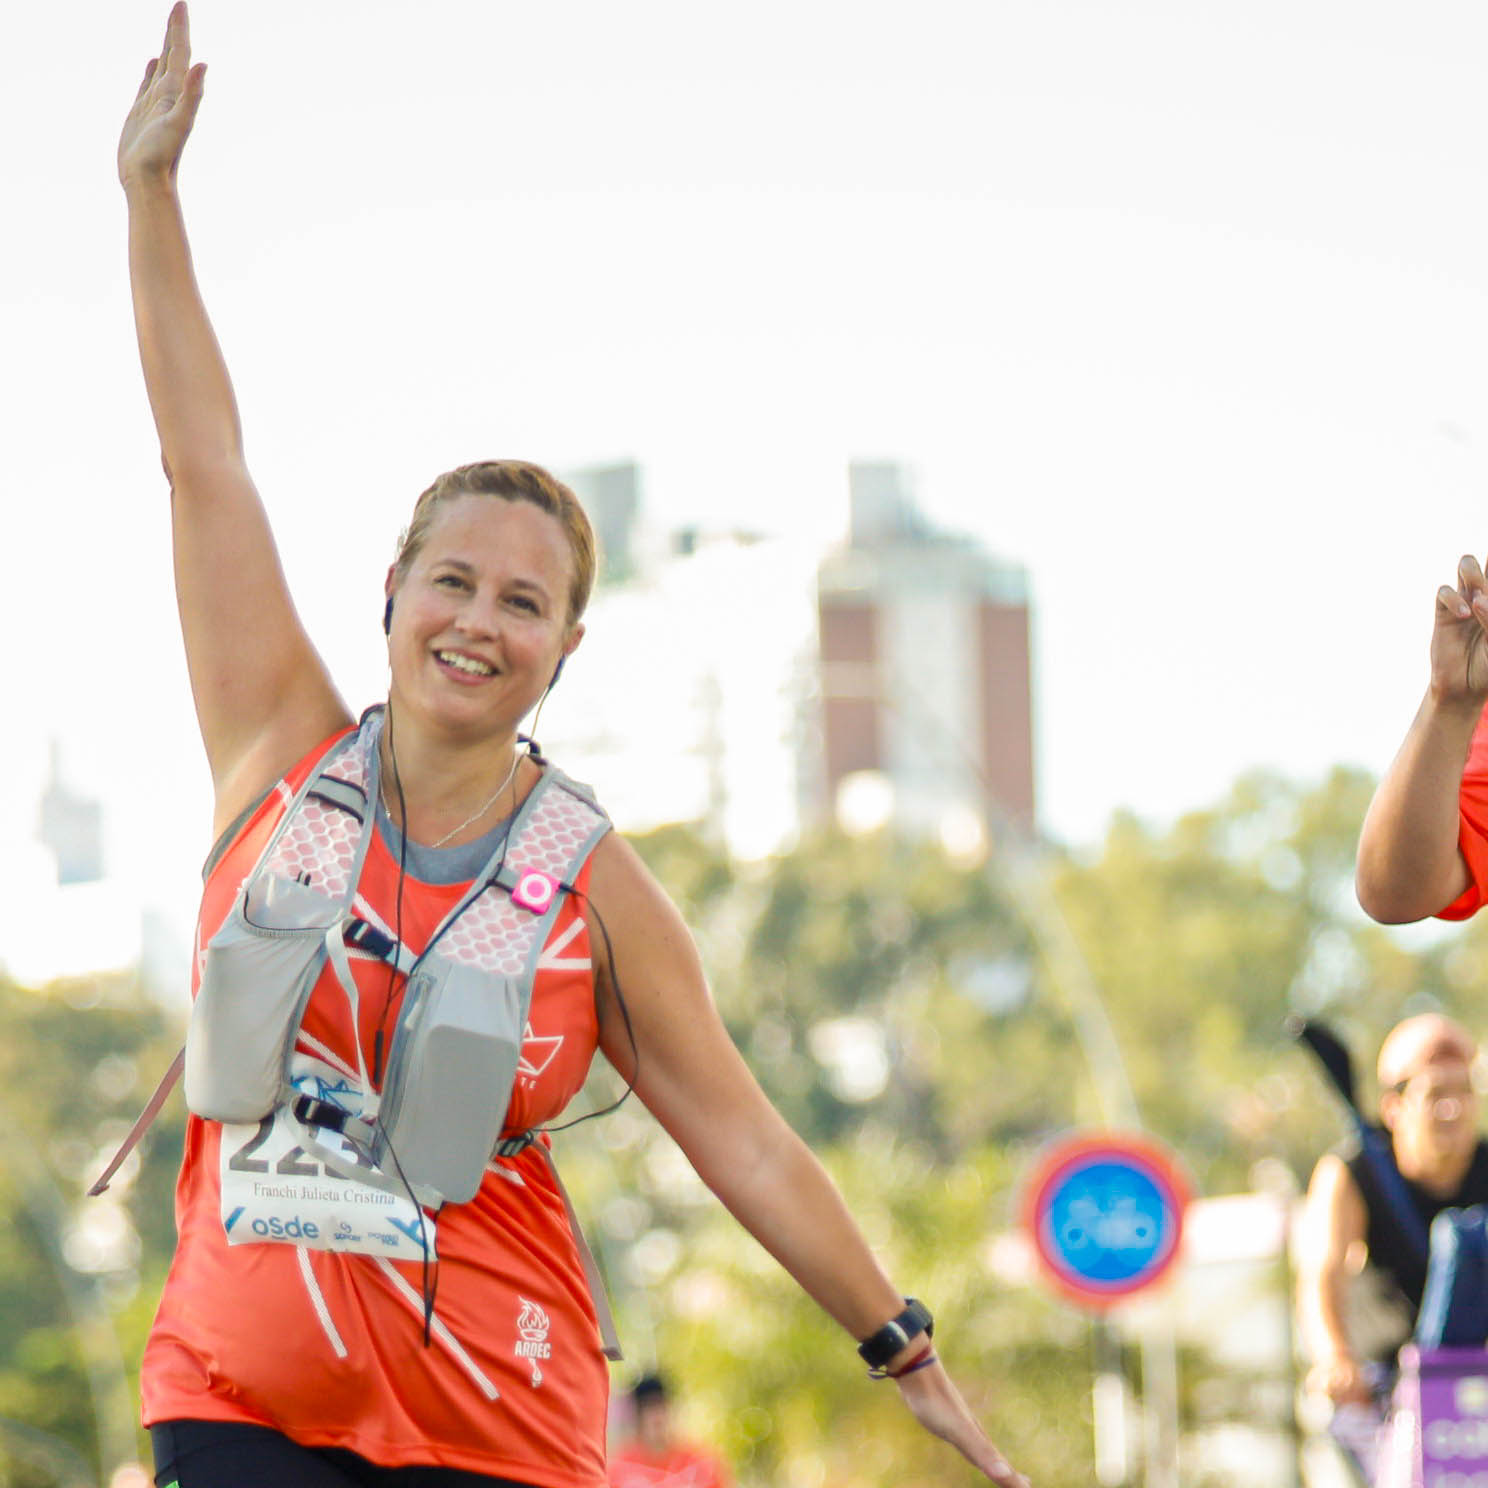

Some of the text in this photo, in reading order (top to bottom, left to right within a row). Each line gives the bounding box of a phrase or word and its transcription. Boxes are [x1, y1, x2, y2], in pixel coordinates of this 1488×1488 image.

[254, 1182, 395, 1205] Franchi Julieta Cristina
[515, 1340, 551, 1359] ARDEC
